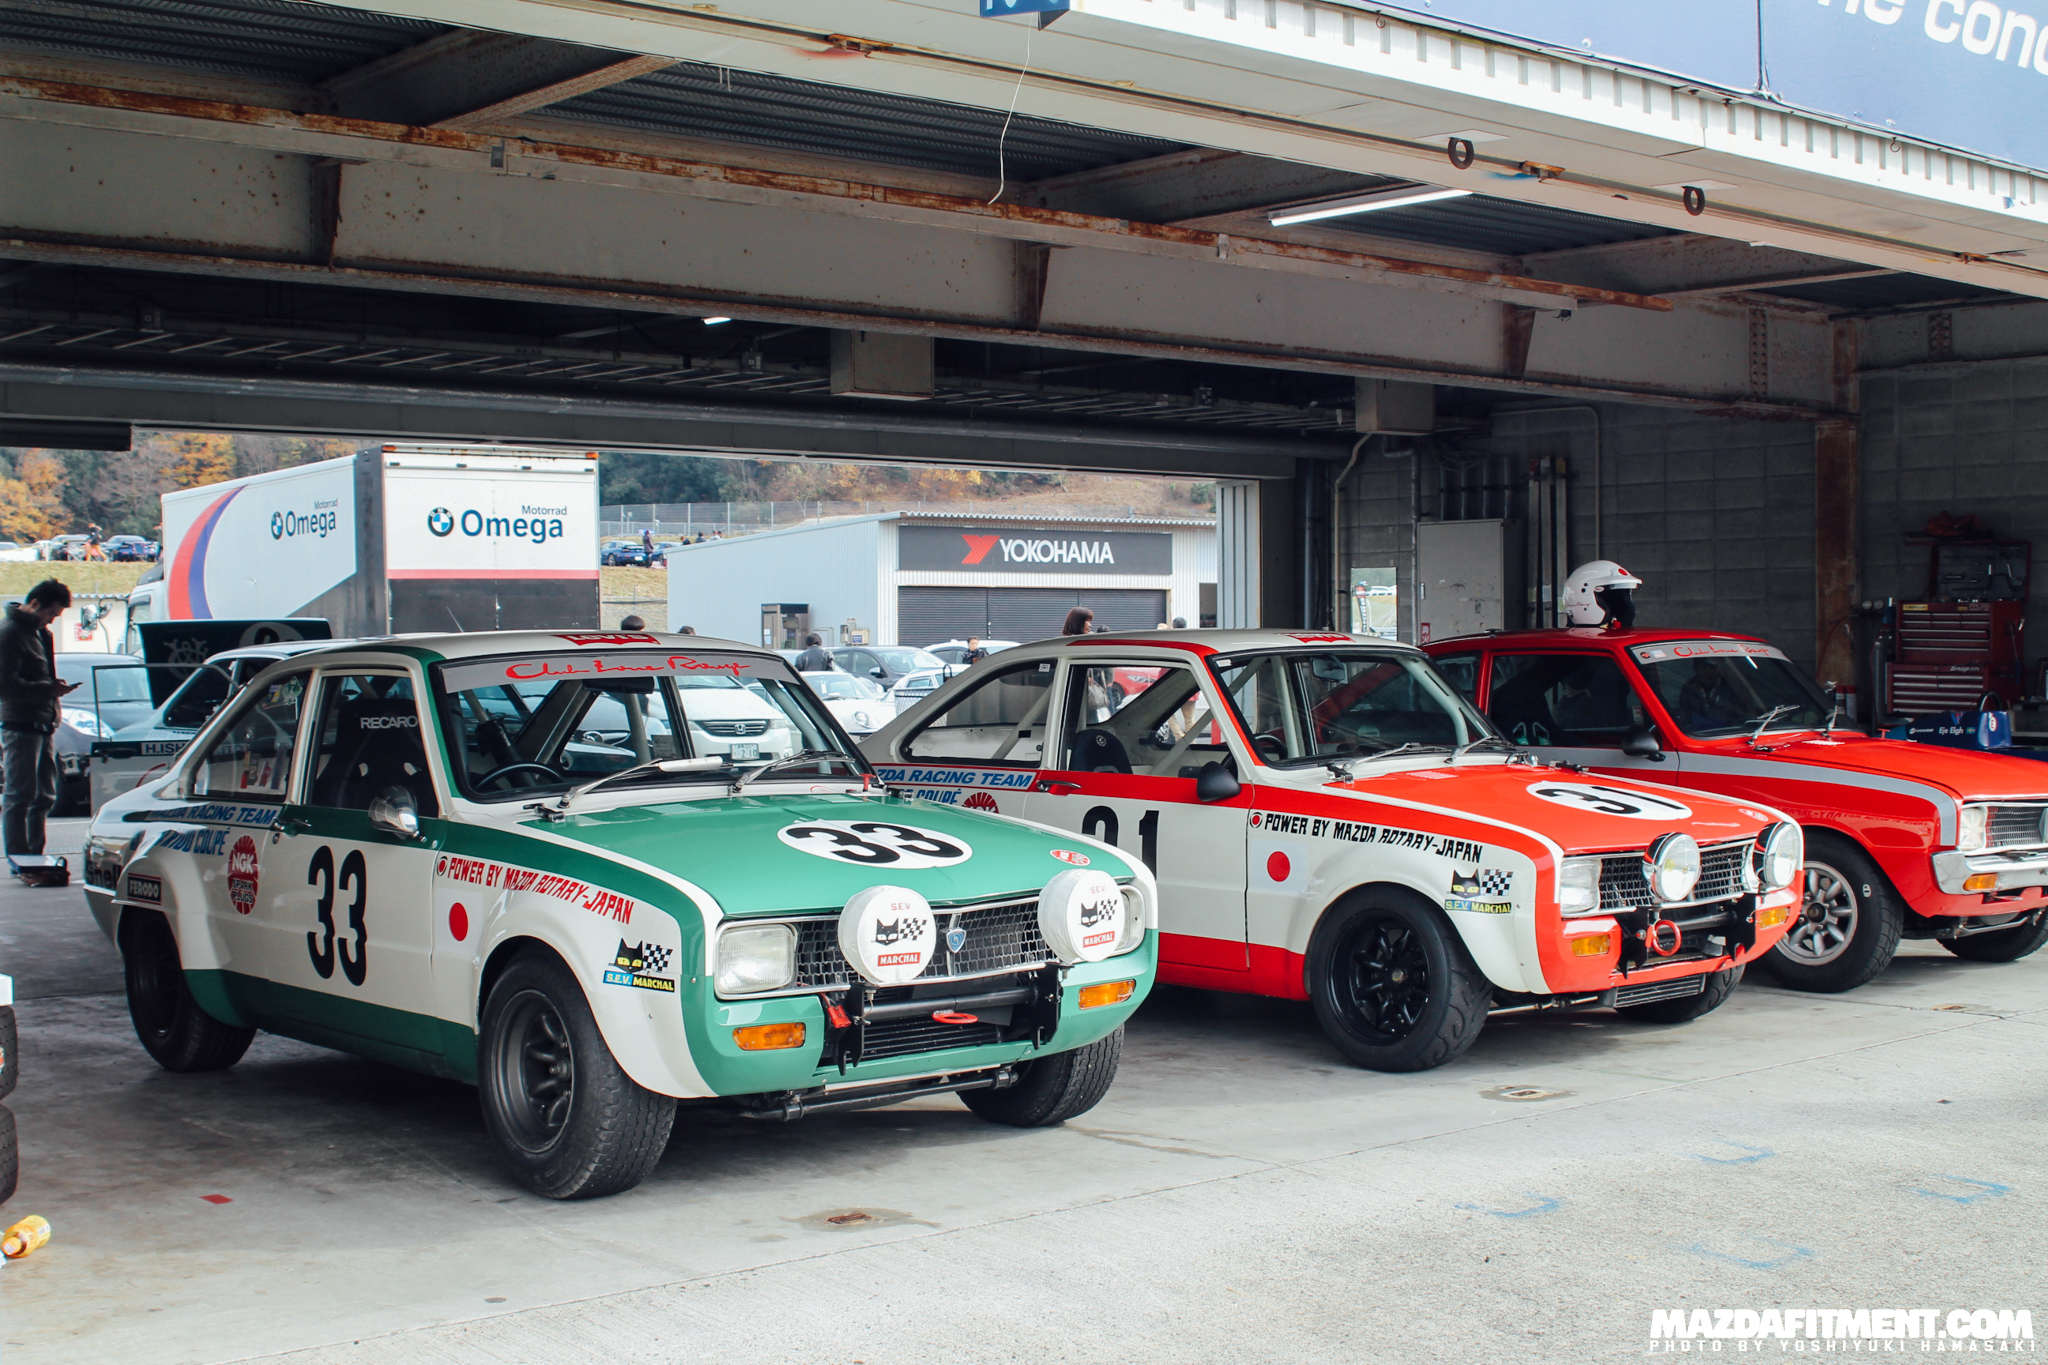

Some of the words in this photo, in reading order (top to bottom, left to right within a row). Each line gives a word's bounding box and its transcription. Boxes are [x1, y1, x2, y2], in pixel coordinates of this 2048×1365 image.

[521, 504, 567, 516] Motorrad
[285, 510, 336, 538] Omega
[461, 509, 563, 544] Omega
[999, 538, 1114, 564] YOKOHAMA
[360, 715, 419, 729] RECARO
[877, 769, 906, 781] ZDA
[908, 769, 976, 784] RACING
[980, 772, 1033, 787] TEAM
[1536, 786, 1688, 815] 31
[187, 804, 236, 821] RACING
[237, 807, 277, 825] TEAM
[193, 827, 231, 856] COUPÉ
[786, 823, 964, 863] 33
[1264, 813, 1308, 835] POWER
[1311, 819, 1331, 837] BY
[1333, 822, 1377, 843] MAZDA
[1378, 828, 1483, 864] ROTARY-JAPAN
[232, 852, 254, 873] NGK
[129, 879, 160, 898] FERODO
[232, 878, 253, 891] SPARK
[448, 857, 485, 885] POWER
[485, 864, 503, 888] BY
[503, 867, 538, 891] MAZDA
[532, 874, 635, 925] ROTARY-JAPAN
[232, 890, 253, 904] PLUGS
[306, 845, 367, 986] 33
[1471, 902, 1511, 914] MARCHAL
[1084, 932, 1114, 946] MARCHAL
[879, 953, 919, 966] MARCHAL
[606, 973, 632, 985] S.E.V.
[632, 976, 674, 991] MARCHAL
